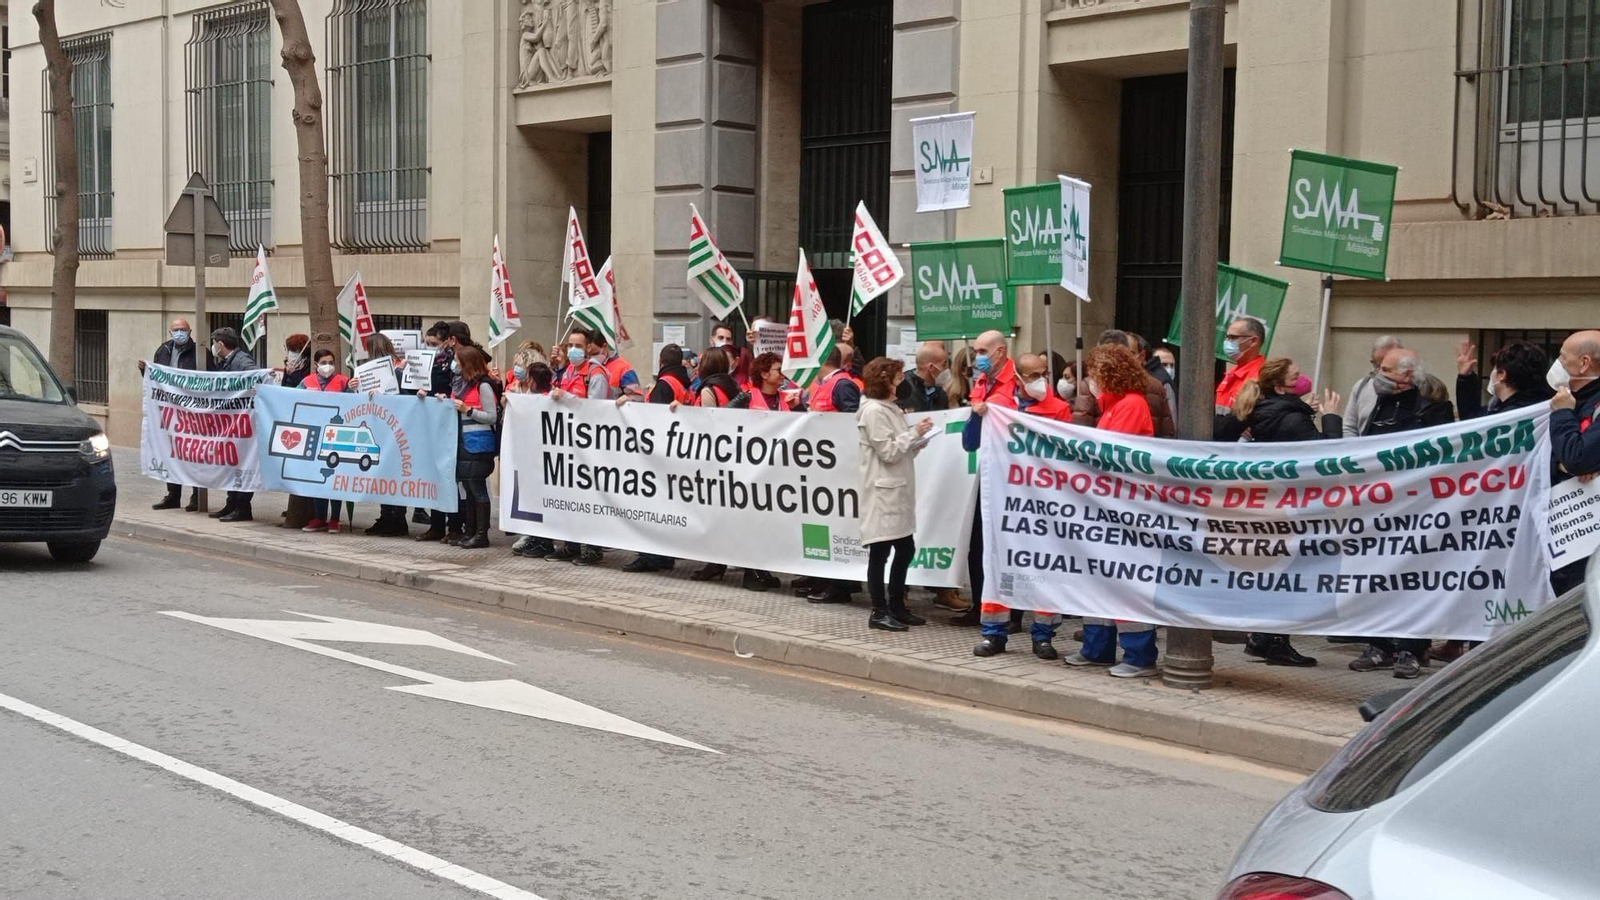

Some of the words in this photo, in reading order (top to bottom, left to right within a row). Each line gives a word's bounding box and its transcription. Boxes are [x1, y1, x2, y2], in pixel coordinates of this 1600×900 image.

[1291, 225, 1323, 237] Sindicato
[1345, 241, 1380, 257] Málaga
[918, 262, 998, 304] SMA
[922, 304, 948, 313] Sindicato
[972, 310, 1003, 320] Málaga
[216, 377, 231, 391] DE
[174, 409, 253, 439] SEGURIDAD
[388, 414, 399, 431] DE
[176, 437, 239, 467] DERECHO
[541, 411, 654, 455] Mismas
[666, 421, 837, 470] funciones
[1007, 422, 1155, 475] SINDICATO
[1166, 454, 1299, 481] MÉDICO
[1315, 456, 1365, 477] DE
[333, 475, 349, 491] EN
[352, 476, 398, 496] ESTADO
[543, 451, 656, 498] Mismas
[667, 468, 859, 518] retribucion
[1007, 464, 1212, 509] DISPOSITIVOS
[1222, 487, 1268, 509] DE
[1276, 481, 1393, 509] APOYO
[1430, 464, 1526, 499] DCCU
[23, 492, 48, 505] KWM
[543, 498, 591, 514] URGENCIAS
[593, 504, 687, 527] EXTRAHOSPITALARIAS
[1004, 496, 1077, 518] MARCO
[1083, 506, 1179, 531] LABORAL
[1185, 517, 1199, 532] Y
[1206, 517, 1364, 535] RETRIBUTIVO
[1374, 513, 1450, 531] ÚNICO
[1461, 504, 1521, 526] PARA
[1550, 511, 1594, 536] Mismas
[1001, 515, 1048, 536] LAS
[1053, 520, 1193, 552] URGENCIAS
[1202, 537, 1290, 556] EXTRA
[1299, 527, 1517, 558] HOSPITALARIAS
[805, 547, 829, 558] SATSE
[833, 546, 843, 555] de
[1006, 548, 1082, 574] IGUAL
[1086, 558, 1203, 587] FUNCIÓN
[1227, 571, 1308, 592] IGUAL
[1316, 565, 1506, 594] RETRIBUCIÓN
